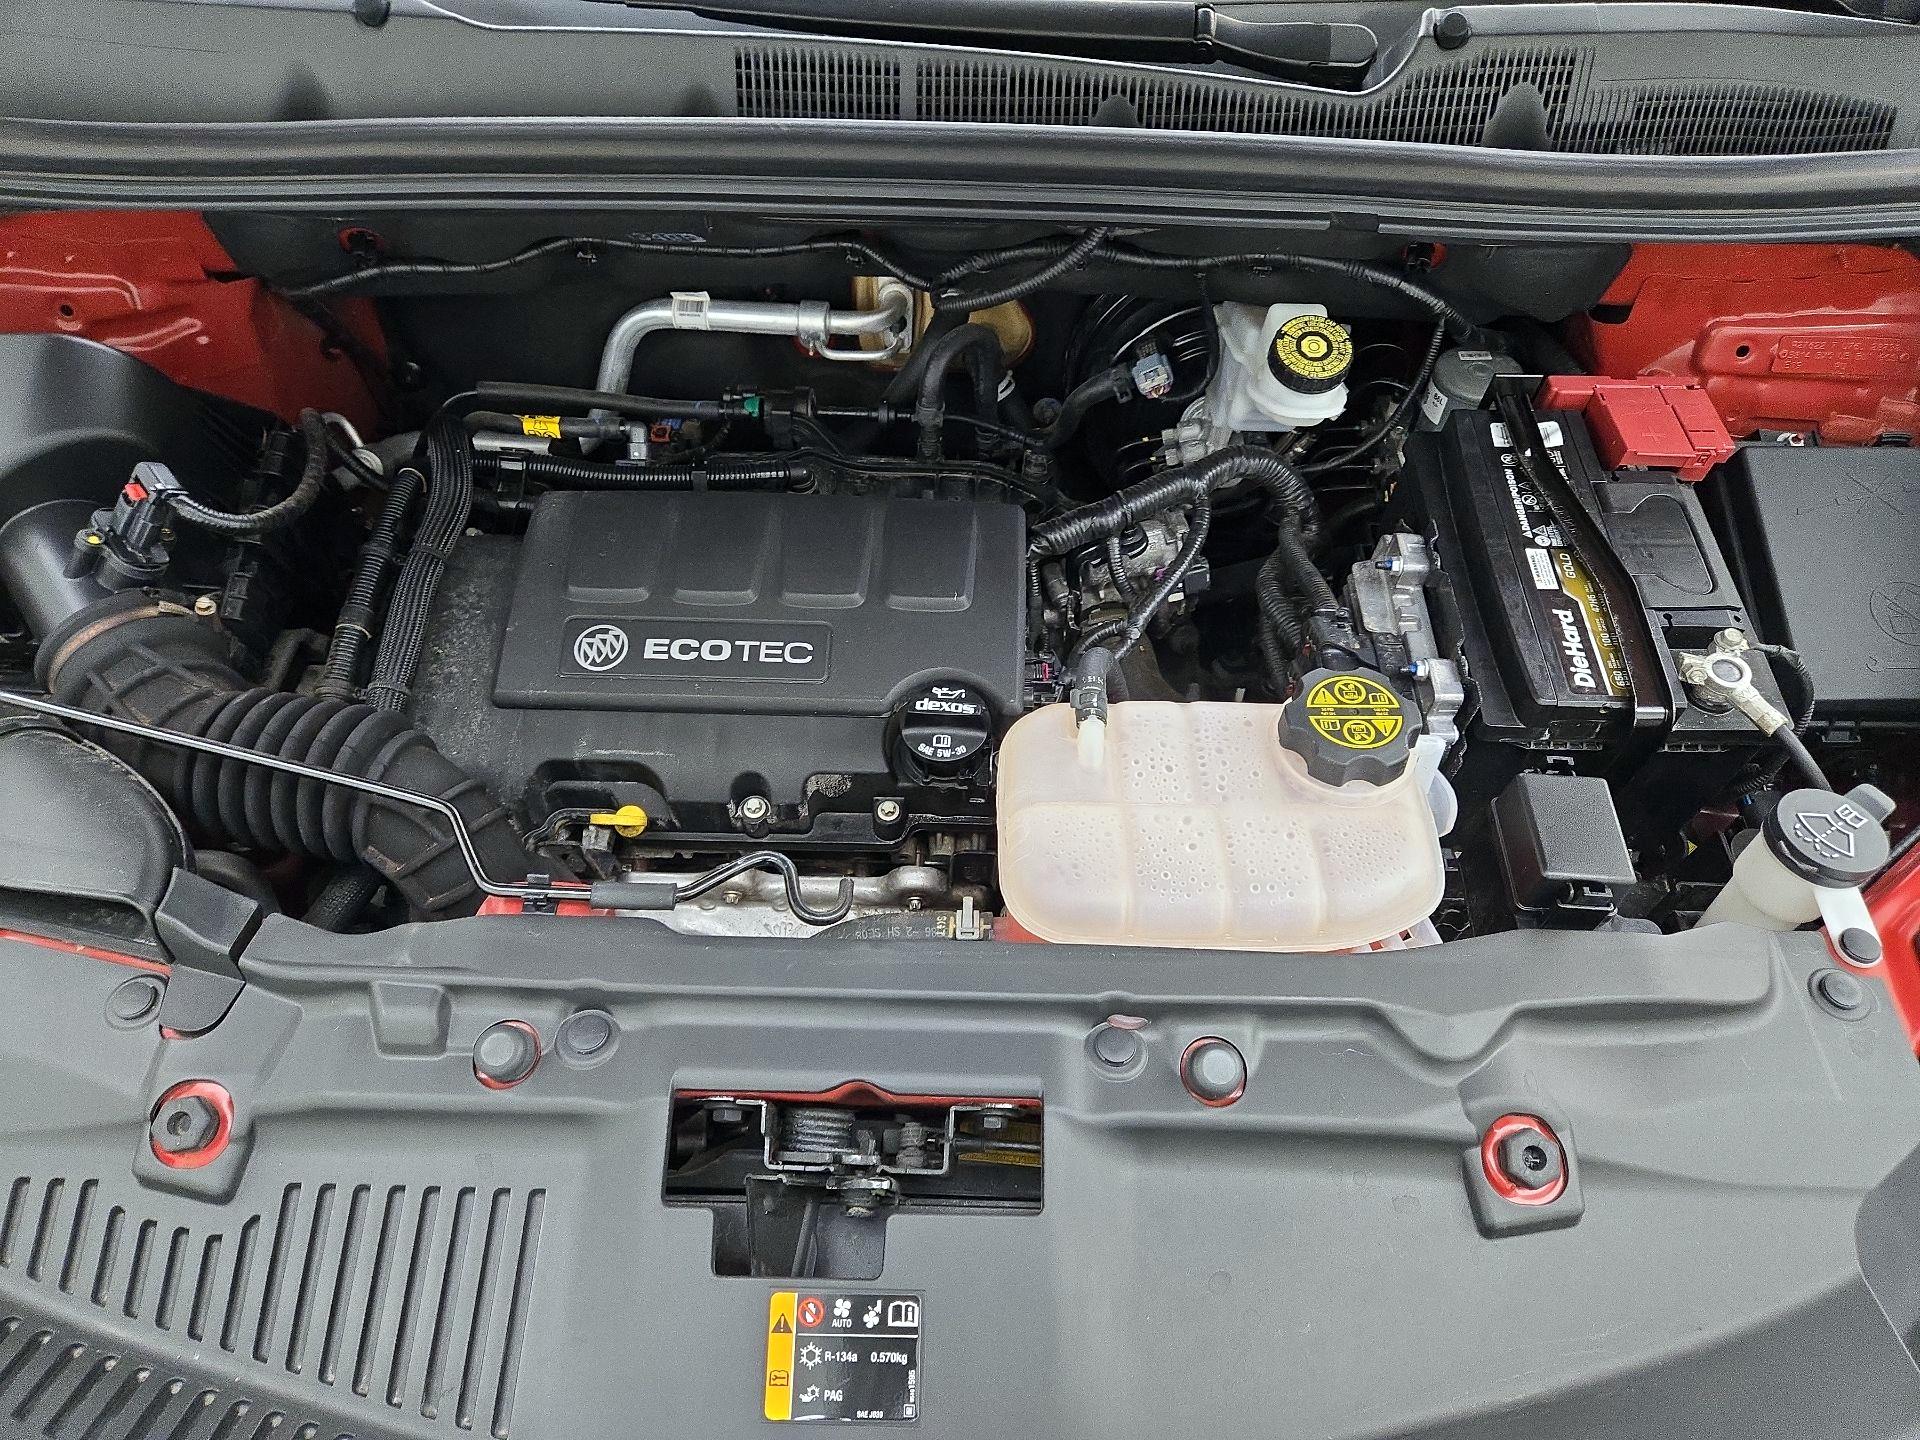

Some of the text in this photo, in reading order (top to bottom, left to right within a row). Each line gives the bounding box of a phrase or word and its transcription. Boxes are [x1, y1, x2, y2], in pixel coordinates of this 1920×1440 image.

[1560, 553, 1577, 579] GOLD
[1600, 632, 1613, 647] 100
[643, 638, 814, 664] ECOTEC
[1552, 608, 1597, 689] DieHard
[914, 697, 977, 715] dexos
[917, 742, 967, 758] SAE 5W-30
[831, 1318, 853, 1328] AUTO
[824, 1350, 908, 1365] R-134a 0.570kg
[823, 1389, 843, 1402] PAG
[856, 1410, 869, 1419] SAE
